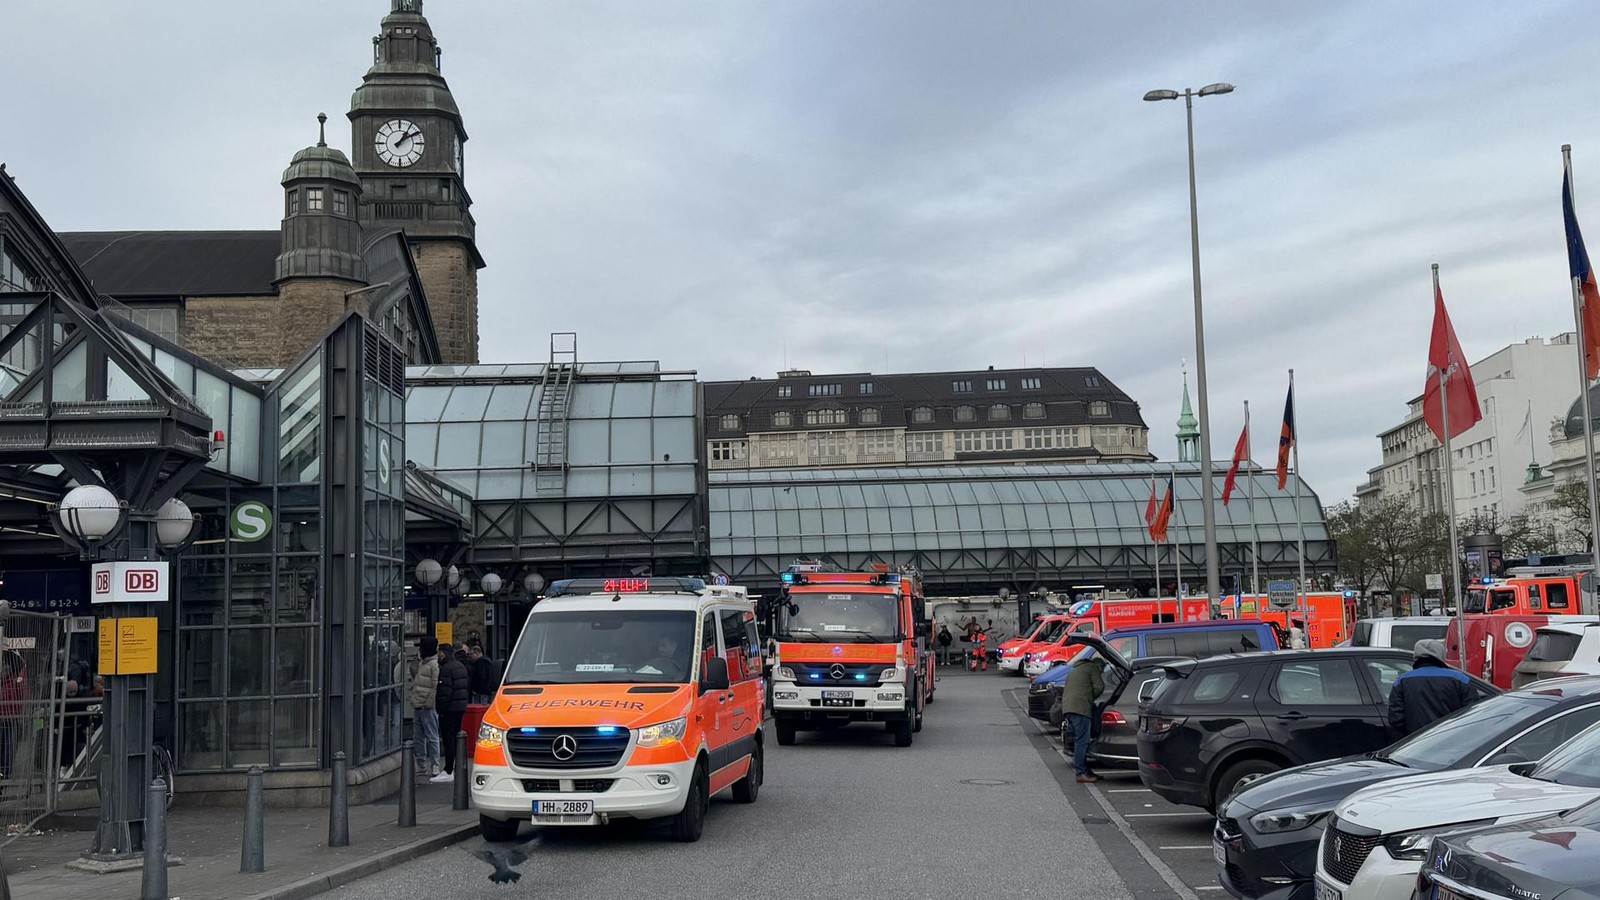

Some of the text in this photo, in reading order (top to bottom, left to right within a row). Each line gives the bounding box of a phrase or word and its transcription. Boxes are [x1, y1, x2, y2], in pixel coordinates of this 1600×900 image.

[380, 439, 389, 484] S
[237, 505, 266, 538] S
[97, 574, 109, 591] DB
[128, 573, 155, 590] DB
[604, 579, 648, 592] 24-ELW-1
[507, 699, 645, 712] FEUERWEHR
[542, 802, 588, 812] HH 2889
